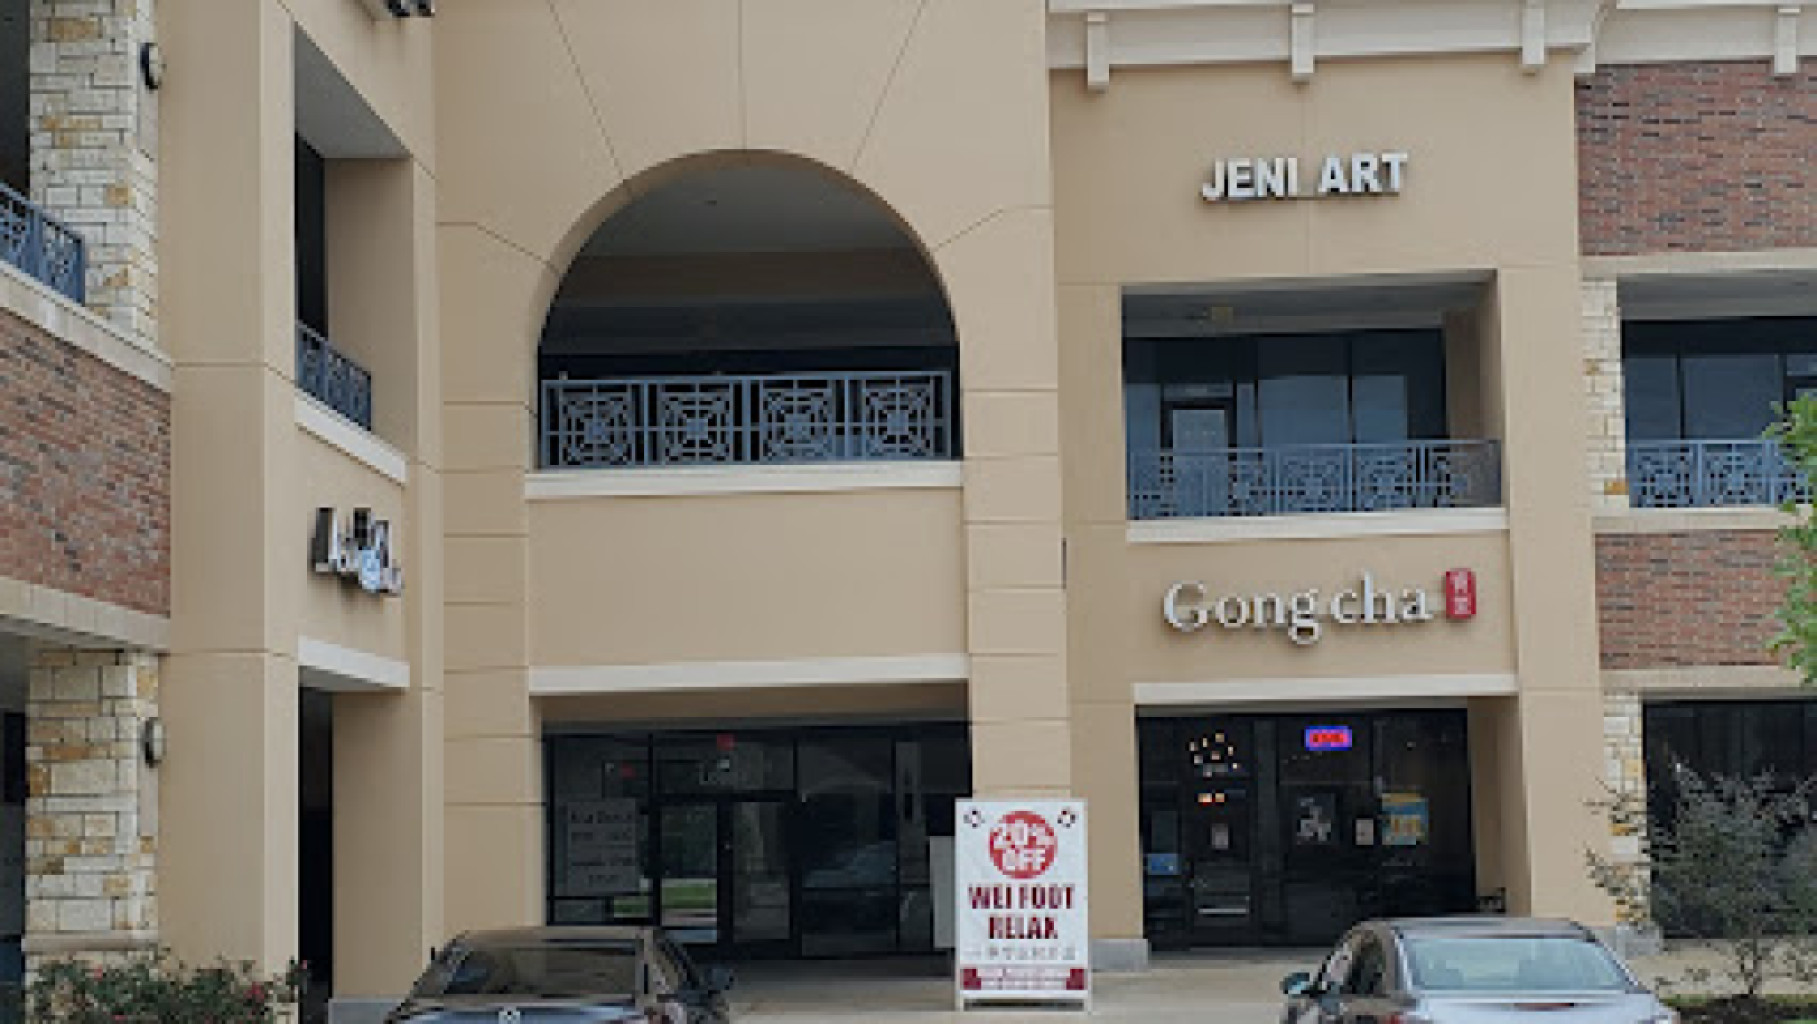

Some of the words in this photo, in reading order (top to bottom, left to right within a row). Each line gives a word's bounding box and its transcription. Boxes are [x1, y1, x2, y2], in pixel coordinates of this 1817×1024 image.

[1201, 156, 1299, 200] JENI
[1317, 151, 1409, 196] ART
[1162, 578, 1322, 646] Gong
[1330, 567, 1434, 625] cha
[967, 883, 1013, 910] WEI
[1017, 883, 1077, 910] FOOT
[987, 914, 1060, 940] RELAX
